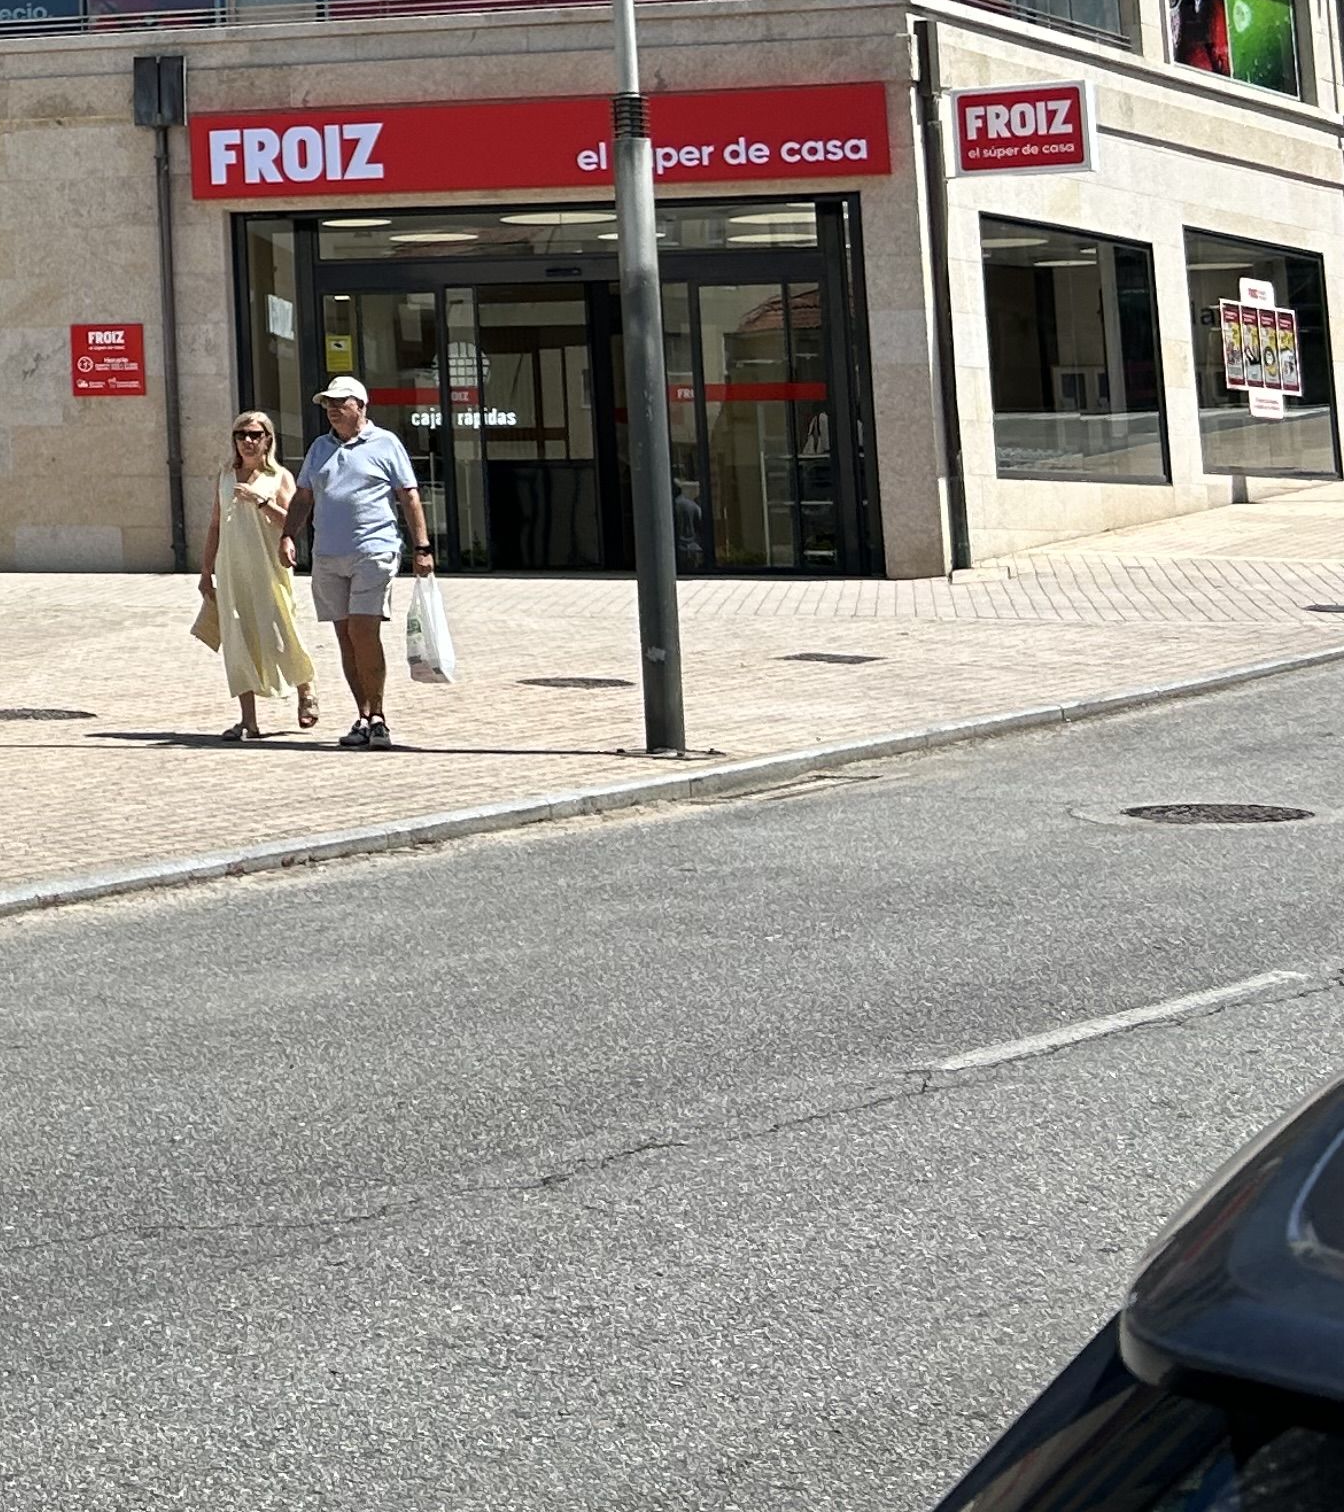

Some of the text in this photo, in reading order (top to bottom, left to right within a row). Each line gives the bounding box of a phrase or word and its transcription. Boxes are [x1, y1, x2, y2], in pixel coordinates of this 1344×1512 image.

[965, 99, 1073, 141] FROIZ
[209, 123, 868, 185] FROIZ el per de casa
[968, 143, 1075, 159] el súper de casa
[87, 331, 125, 344] FROIZ
